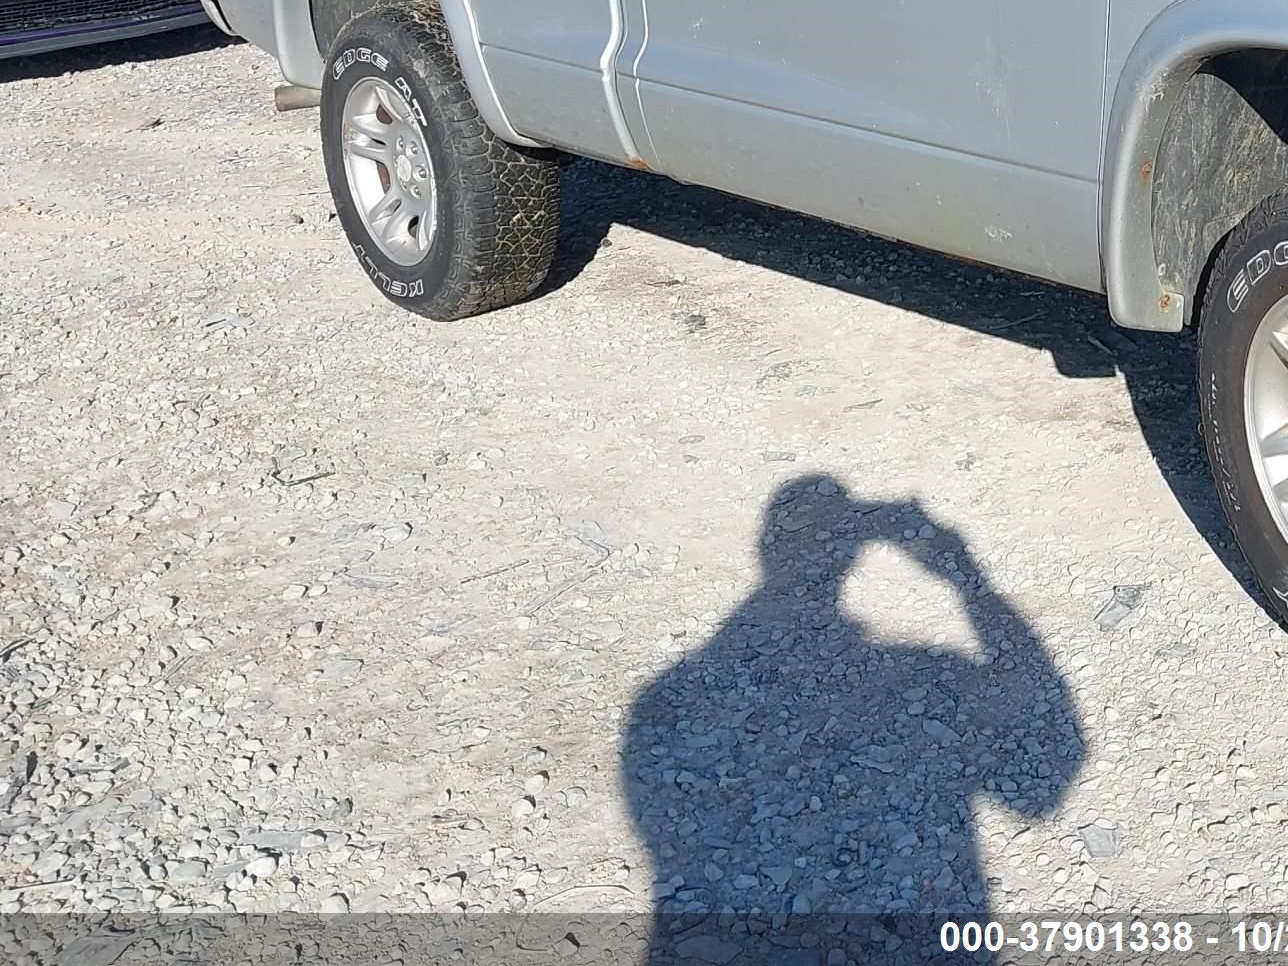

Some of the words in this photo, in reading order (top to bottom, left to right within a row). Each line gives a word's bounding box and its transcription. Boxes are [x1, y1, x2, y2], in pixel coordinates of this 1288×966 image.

[333, 47, 389, 81] EDGE
[394, 77, 428, 127] AT
[351, 241, 424, 297] KELLY
